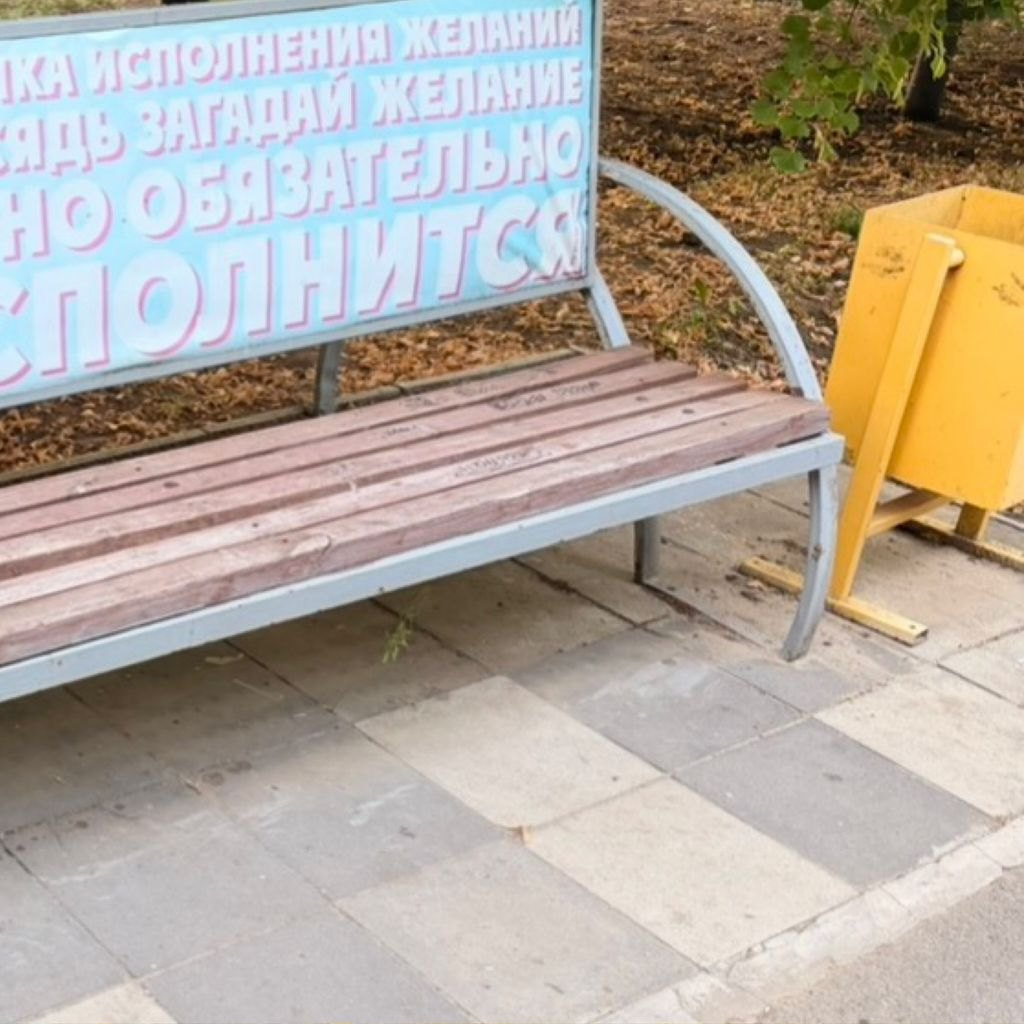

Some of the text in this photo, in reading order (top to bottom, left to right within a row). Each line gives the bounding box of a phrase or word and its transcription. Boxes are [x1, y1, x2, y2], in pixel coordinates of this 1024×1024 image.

[87, 22, 392, 95] ИСПОЛНЕНИЯ
[401, 2, 583, 61] ЖЕЛАНИЙ
[137, 72, 358, 157] ЗАГАДАЙ
[370, 59, 583, 127] ЖЕЛАНИЕ
[125, 117, 584, 241] ОБЯЗАТЕЛЬНО
